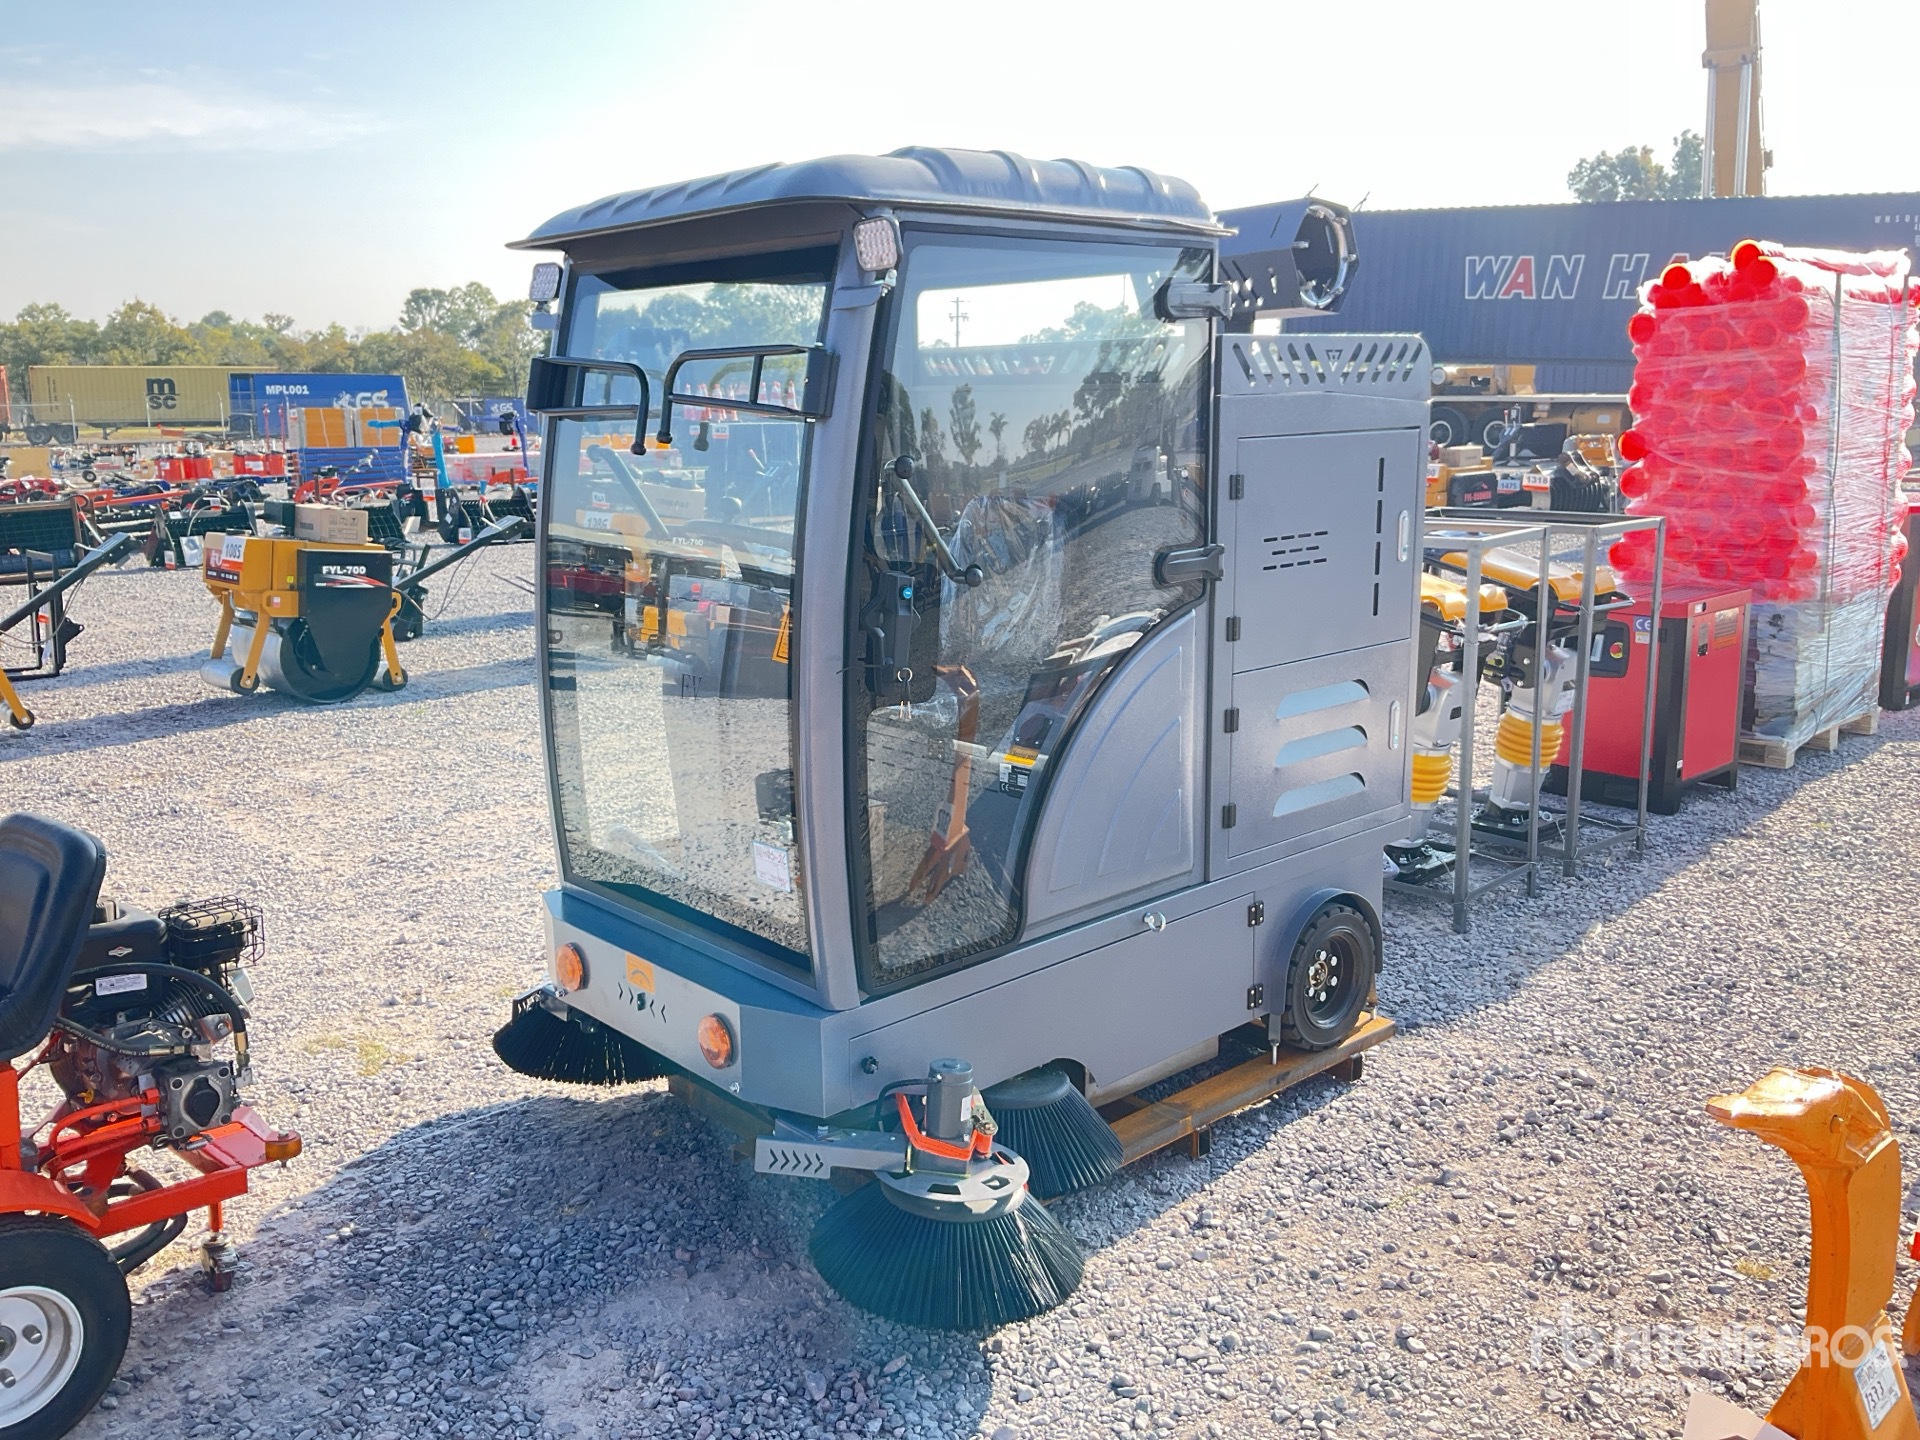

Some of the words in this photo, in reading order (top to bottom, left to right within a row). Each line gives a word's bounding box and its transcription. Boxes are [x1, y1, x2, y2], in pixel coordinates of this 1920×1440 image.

[1464, 254, 1586, 300] WAN
[265, 384, 310, 395] MPL001
[1526, 475, 1549, 484] 1318
[225, 543, 242, 559] 1085
[322, 566, 367, 575] FYL-700
